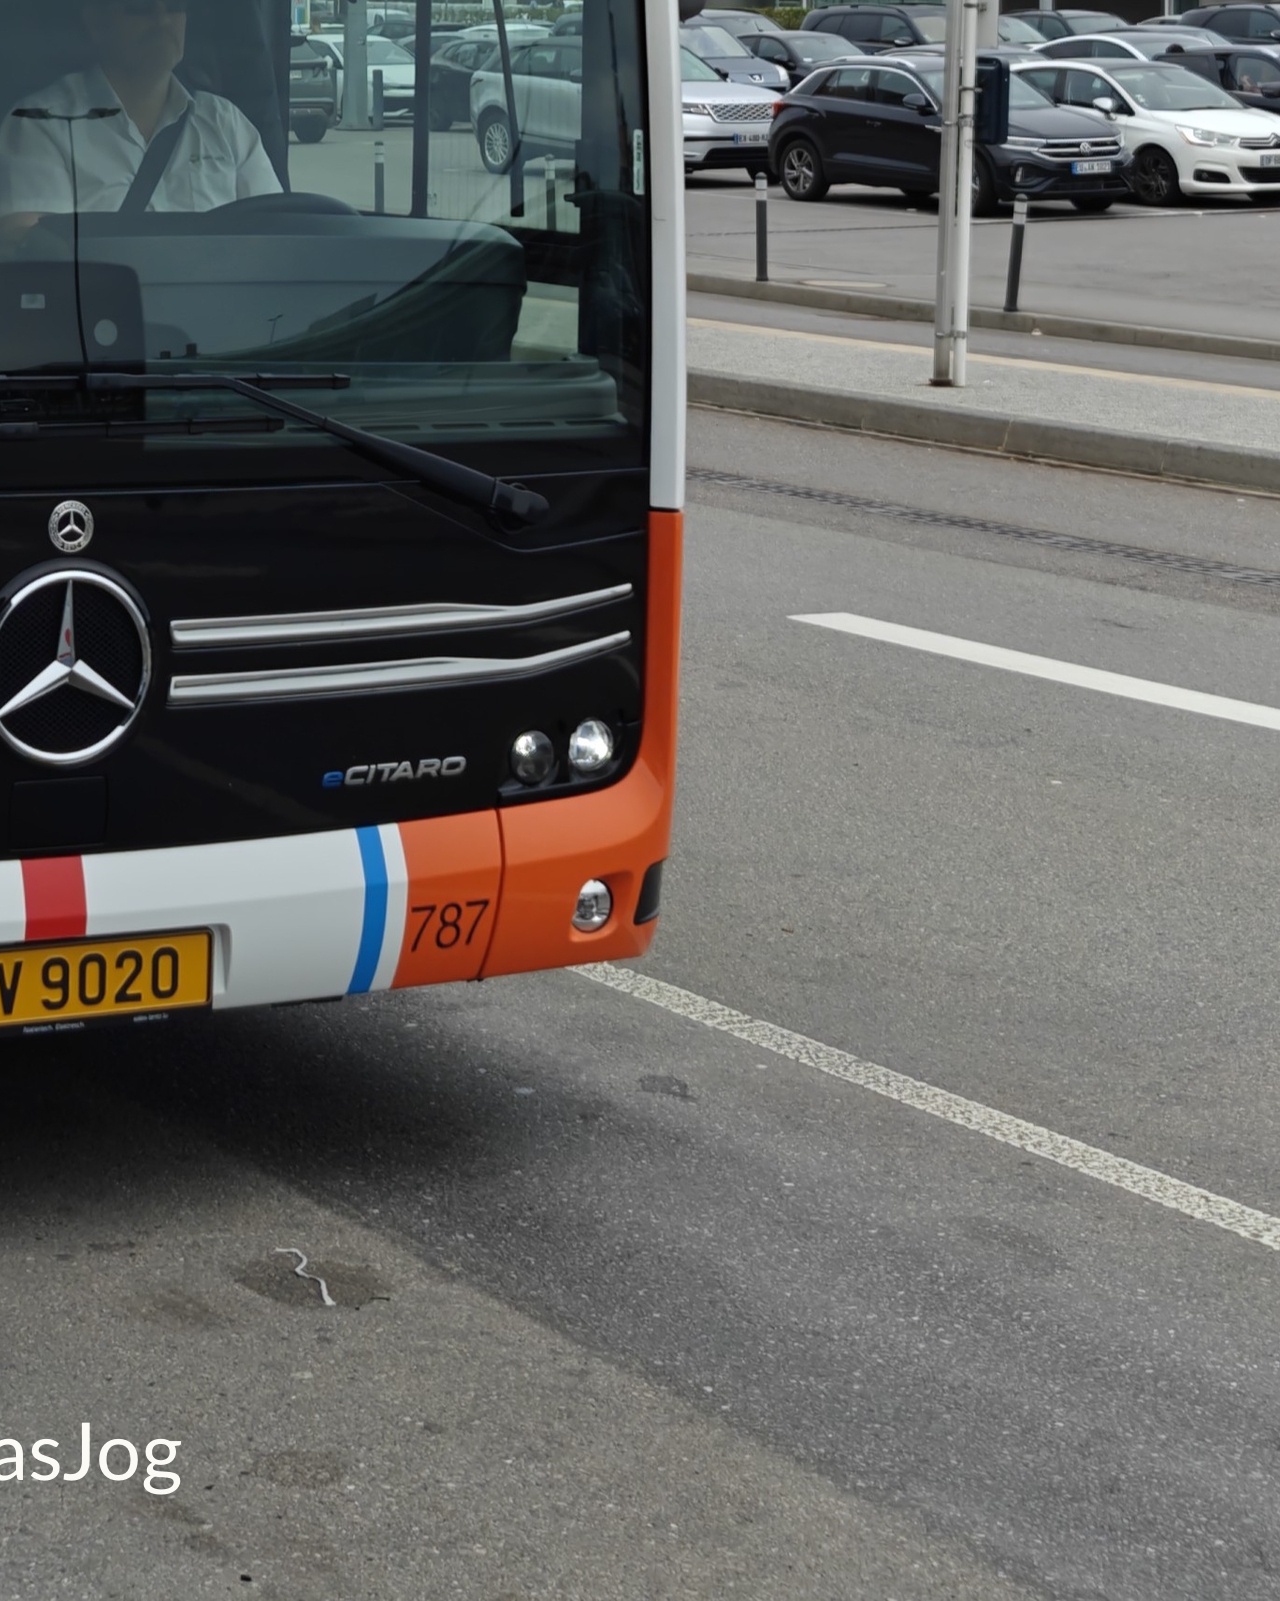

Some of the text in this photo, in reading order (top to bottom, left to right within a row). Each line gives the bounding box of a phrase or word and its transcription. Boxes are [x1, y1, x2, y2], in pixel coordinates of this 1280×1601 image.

[321, 755, 467, 788] eCITARO
[409, 899, 490, 953] 787
[40, 945, 180, 1011] 9020
